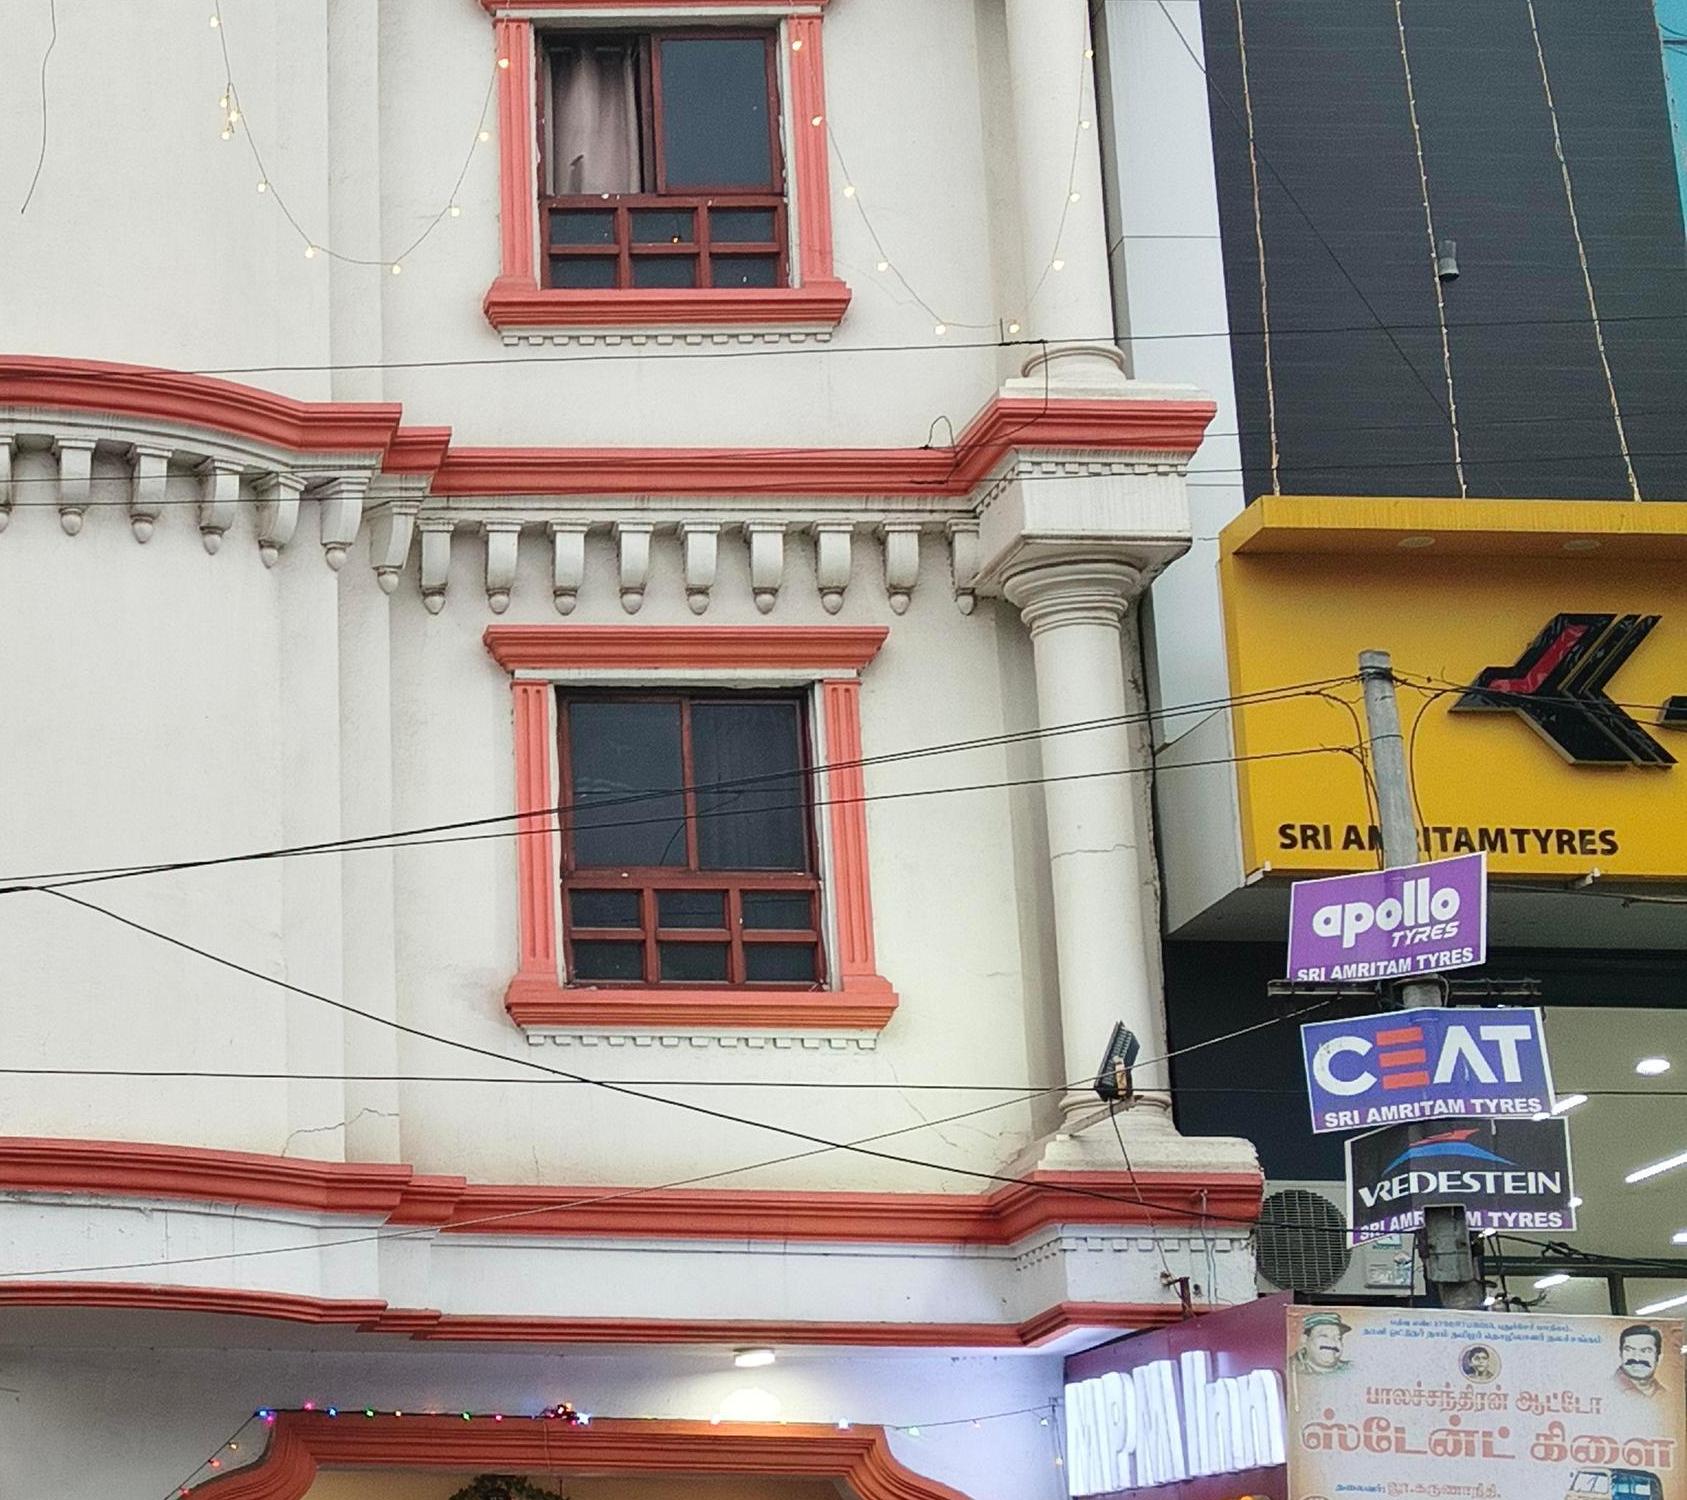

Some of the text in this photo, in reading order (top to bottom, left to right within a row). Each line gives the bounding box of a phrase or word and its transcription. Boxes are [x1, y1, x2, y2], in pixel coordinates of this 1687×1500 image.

[1278, 823, 1332, 850] SRI
[1312, 877, 1461, 949] apollo
[1390, 920, 1461, 948] TYRES
[1296, 946, 1474, 982] SRI AMRITAM TYRES
[1312, 1025, 1532, 1097] CEAT
[1324, 1098, 1543, 1129] SRI AMRITAM TYRES
[1357, 1170, 1561, 1208] VREDESTEIN
[1486, 1211, 1564, 1229] TYRES
[1180, 1350, 1288, 1477] Inn
[1529, 1421, 1677, 1468] கிளை
